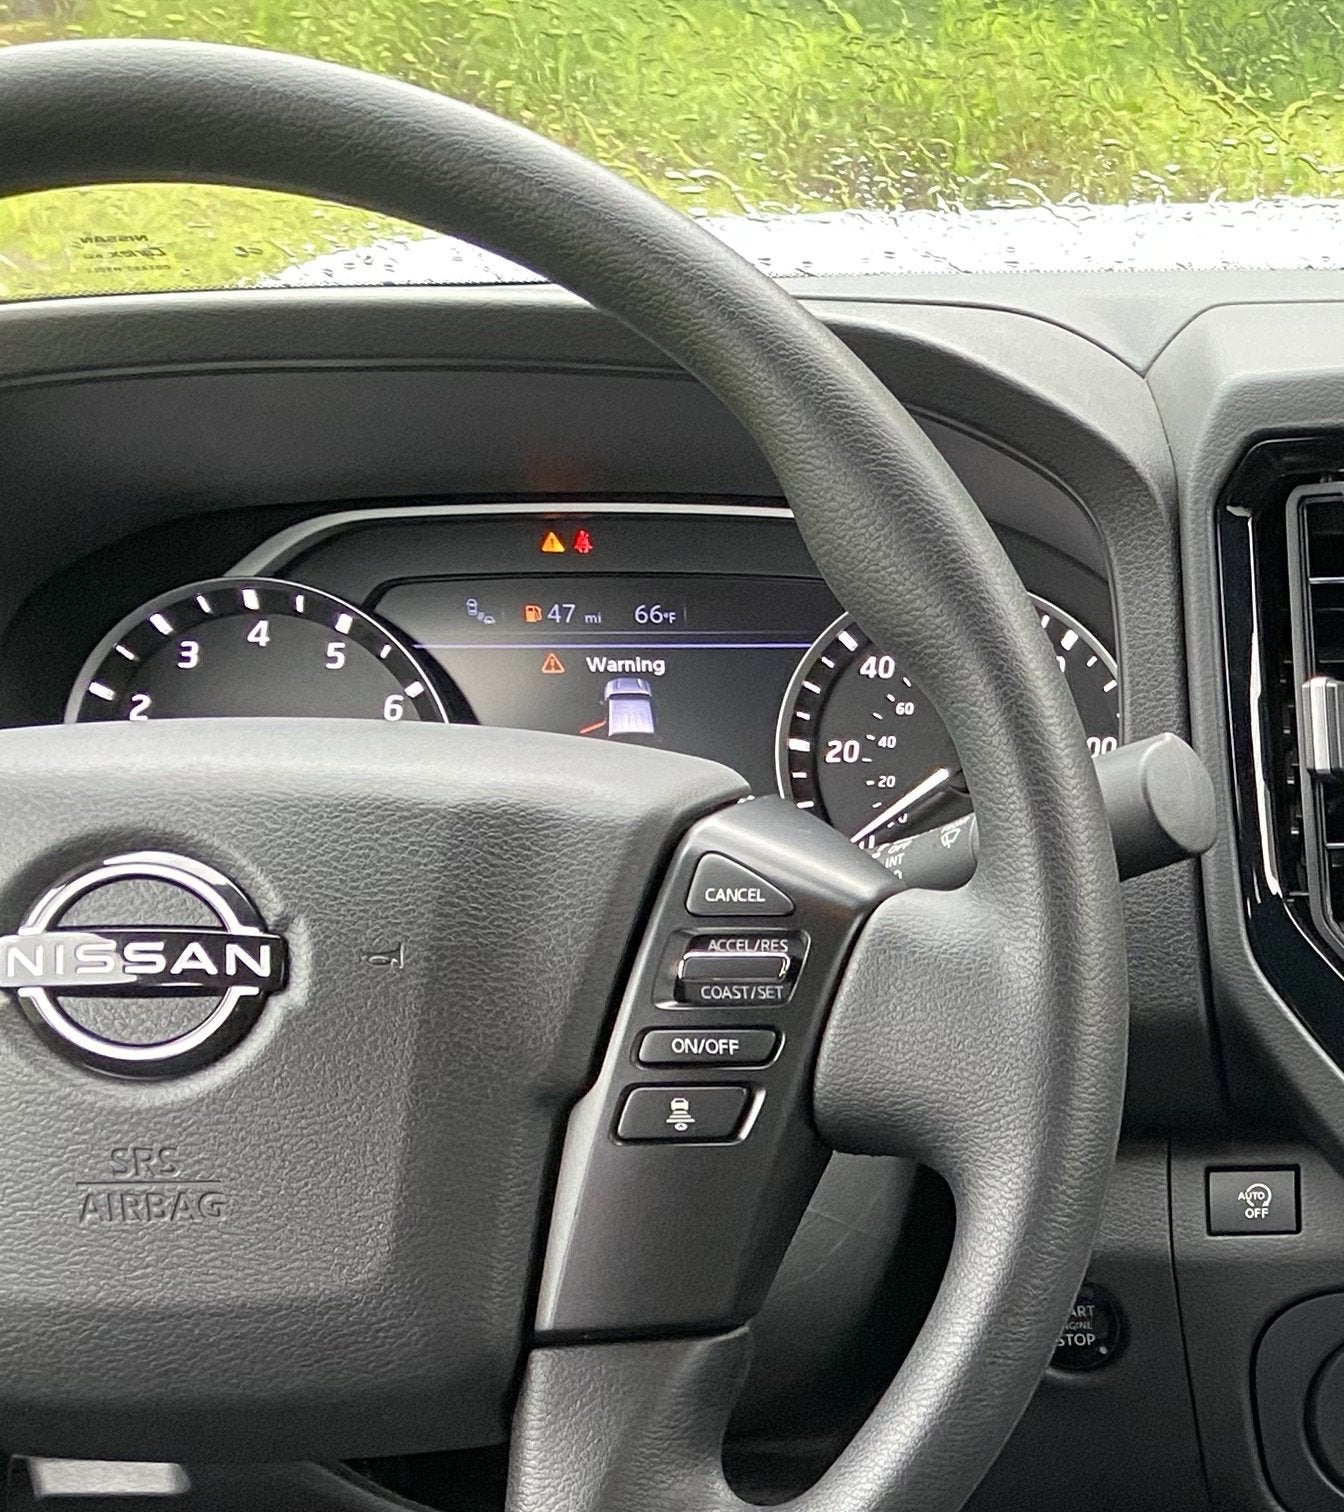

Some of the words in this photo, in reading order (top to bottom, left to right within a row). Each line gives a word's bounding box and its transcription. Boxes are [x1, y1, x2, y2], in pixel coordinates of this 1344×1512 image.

[547, 604, 576, 624] 47
[584, 612, 601, 624] mi
[247, 620, 271, 647] 4
[178, 641, 199, 669] 3
[325, 642, 346, 669] 5
[585, 656, 666, 676] Warning
[860, 655, 896, 679] 40
[129, 695, 151, 722] 2
[383, 695, 404, 722] 6
[895, 702, 915, 716] 60
[825, 739, 860, 763] 20
[877, 735, 897, 749] 40
[877, 775, 896, 788] 20
[885, 852, 905, 869] INT
[704, 888, 767, 902] CANCEL
[708, 939, 789, 952] ACCEL/RES
[7, 942, 271, 977] NISSAN
[701, 985, 785, 1000] COAST/SET
[671, 1037, 740, 1055] ON/OFF
[109, 1146, 181, 1180] SRS
[1238, 1191, 1265, 1201] AUTO
[77, 1190, 226, 1225] AIRBAG
[1244, 1207, 1269, 1219] OFF
[1056, 1332, 1096, 1347] STOP
